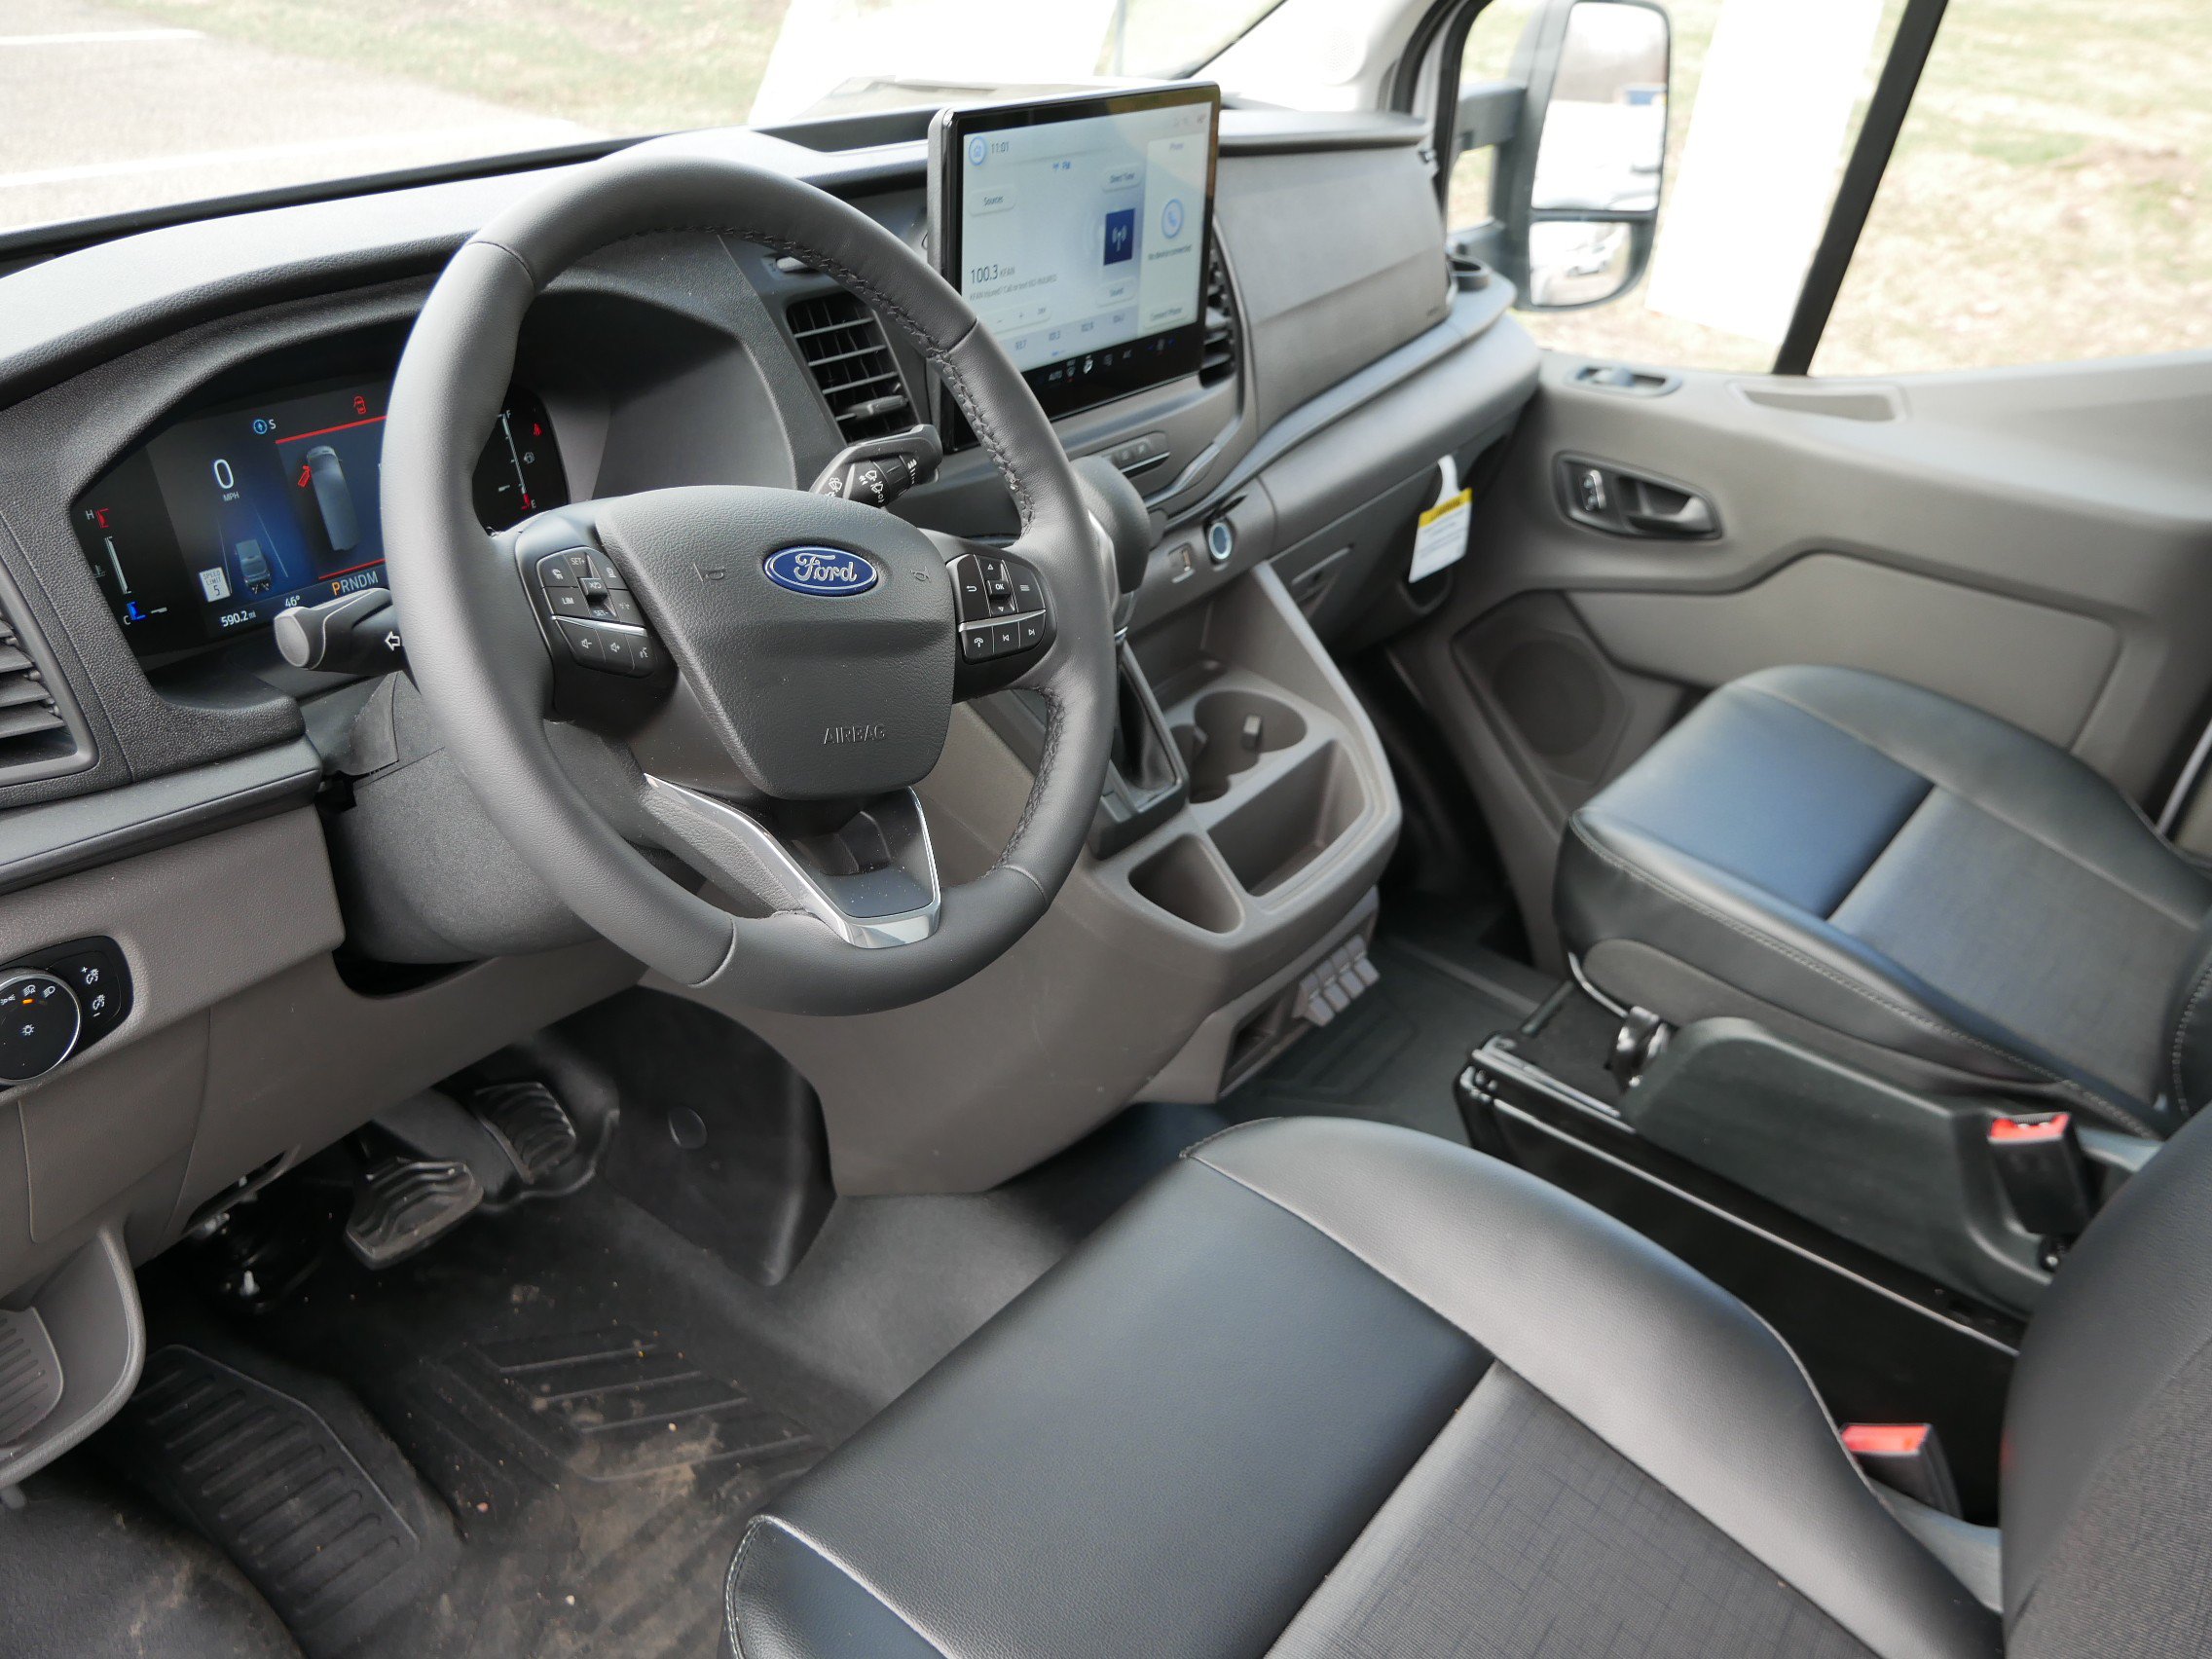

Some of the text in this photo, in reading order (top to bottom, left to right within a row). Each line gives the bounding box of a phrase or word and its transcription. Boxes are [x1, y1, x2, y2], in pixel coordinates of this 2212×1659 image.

[971, 264, 999, 284] 100.3
[506, 409, 512, 419] F
[268, 419, 276, 429] S
[213, 458, 235, 490] 0
[223, 491, 240, 502] MPH
[531, 498, 536, 509] E
[85, 509, 94, 520] H
[571, 557, 586, 566] SET+
[793, 552, 858, 582] Ford
[203, 570, 222, 581] SPEED
[205, 576, 223, 587] LIMIT
[213, 585, 221, 597] 5
[123, 614, 131, 626] C
[221, 610, 257, 628] 590.2 mi
[823, 724, 886, 745] AIRBAG
